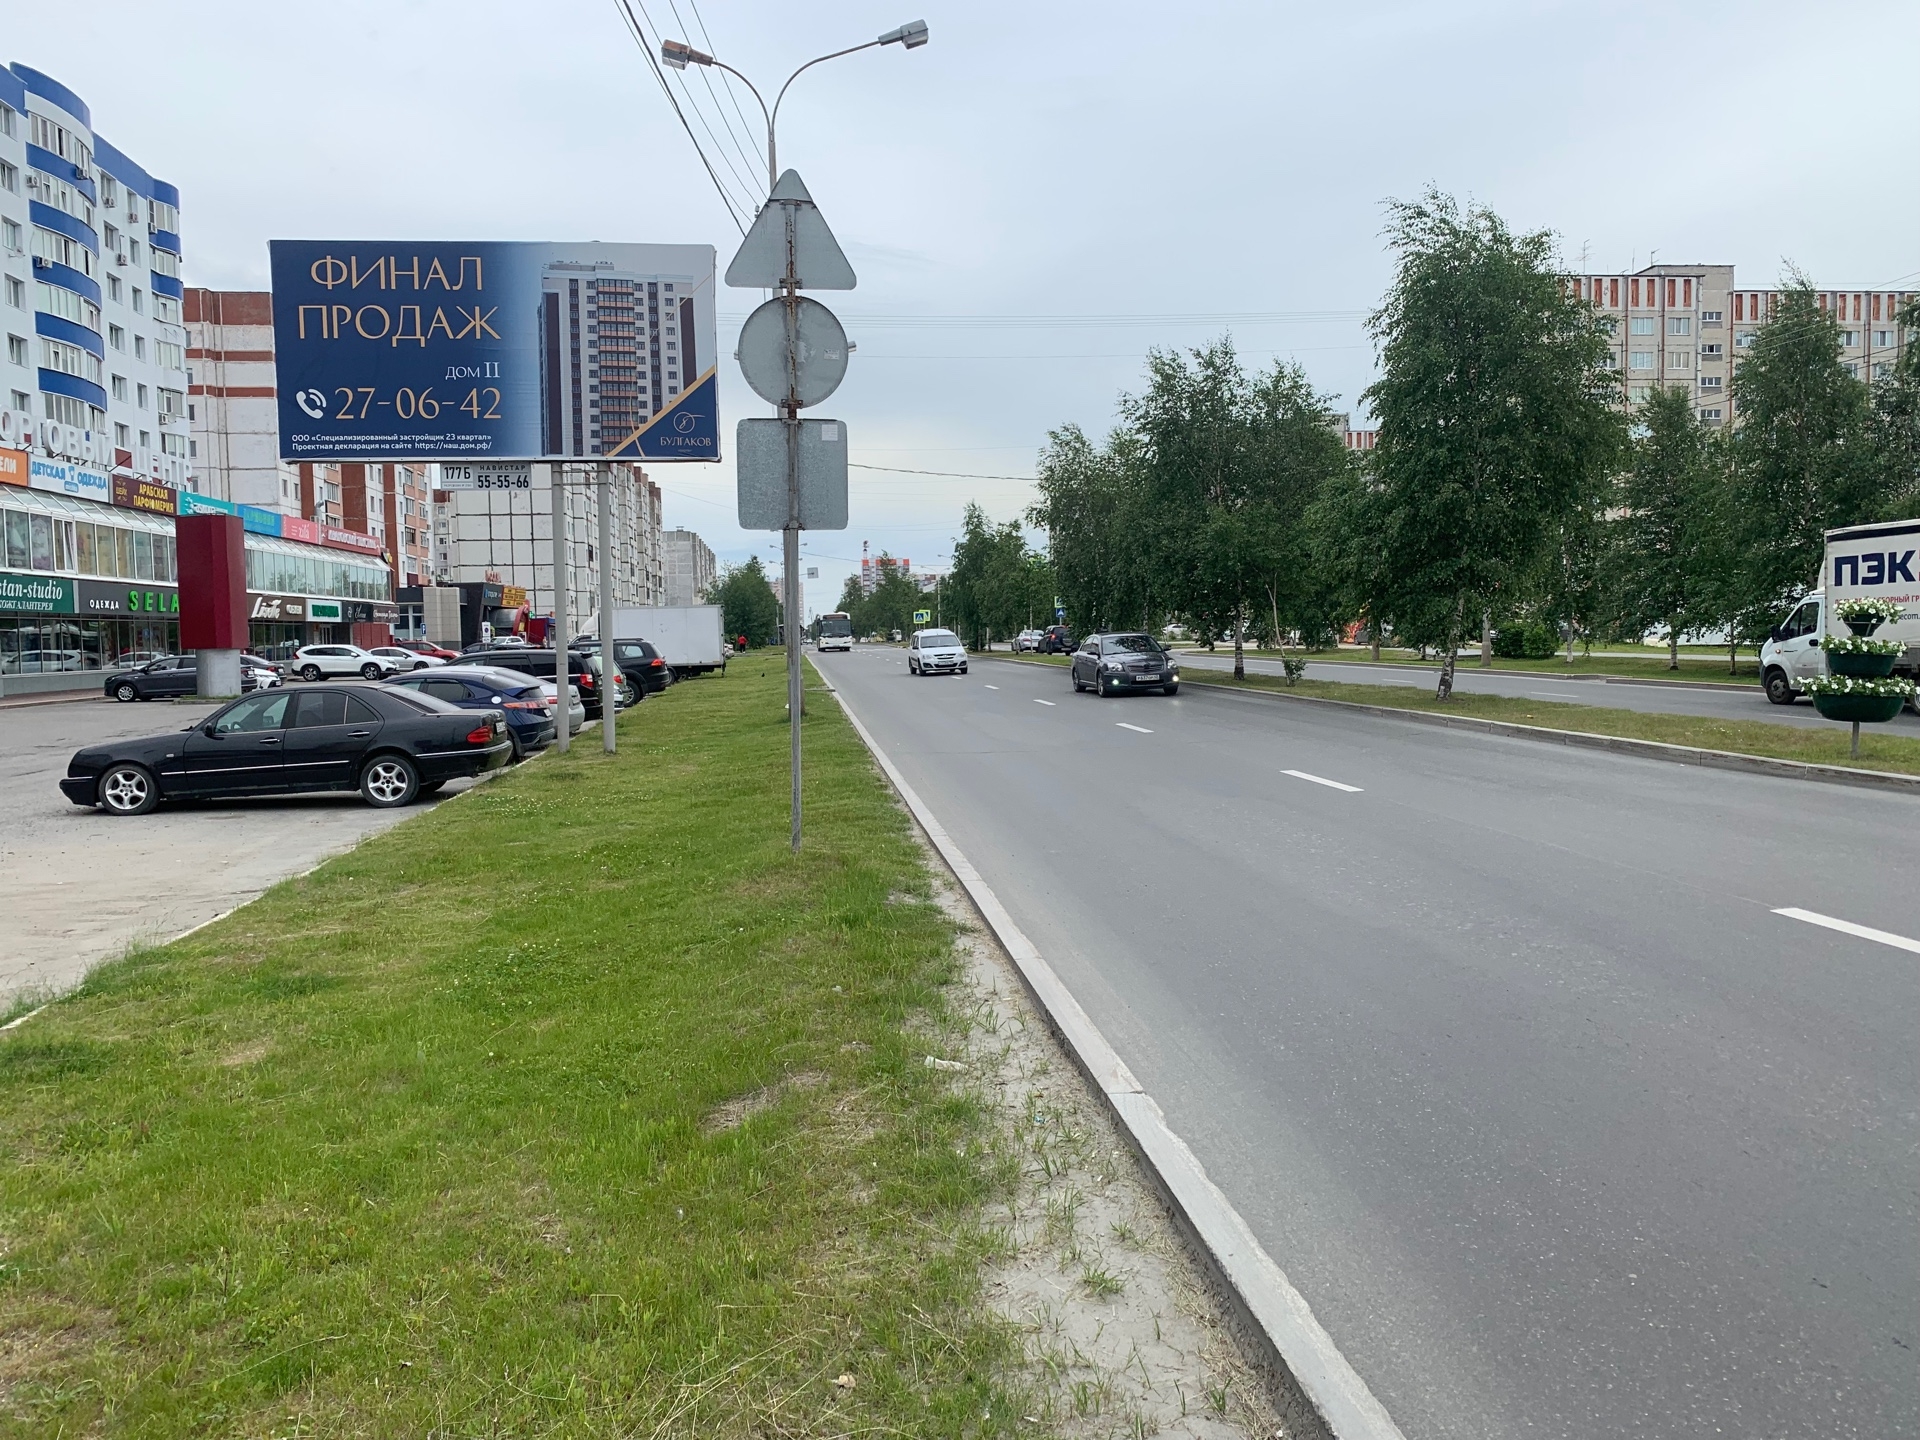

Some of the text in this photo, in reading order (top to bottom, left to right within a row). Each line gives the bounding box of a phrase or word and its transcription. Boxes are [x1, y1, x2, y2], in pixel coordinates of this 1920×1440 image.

[310, 255, 482, 291] ФИНАЛ
[298, 304, 502, 348] ПРОДАЖ
[334, 386, 502, 420] 27-06-42
[291, 433, 492, 443] ООО «Специализированный застройщик 23 квартал»
[292, 443, 333, 452] Проектная
[334, 442, 380, 451] декларация
[414, 441, 492, 450] https://наш.дом.рф/
[660, 436, 712, 447] БУЛГАКОВ
[31, 461, 66, 480] ДЕТСКАЯ
[77, 471, 108, 490] ОДЕЖДА
[444, 466, 461, 480] 177
[477, 475, 529, 489] 55-55-66
[139, 483, 168, 500] АРАБСКАЯ
[1834, 550, 1917, 587] ПЭК
[0, 579, 63, 600] tan-studio
[0, 600, 54, 611] ОЖГАЛАНТЕРЕЯ
[89, 599, 120, 610] ОДЕЖДА
[128, 590, 179, 613] SELA
